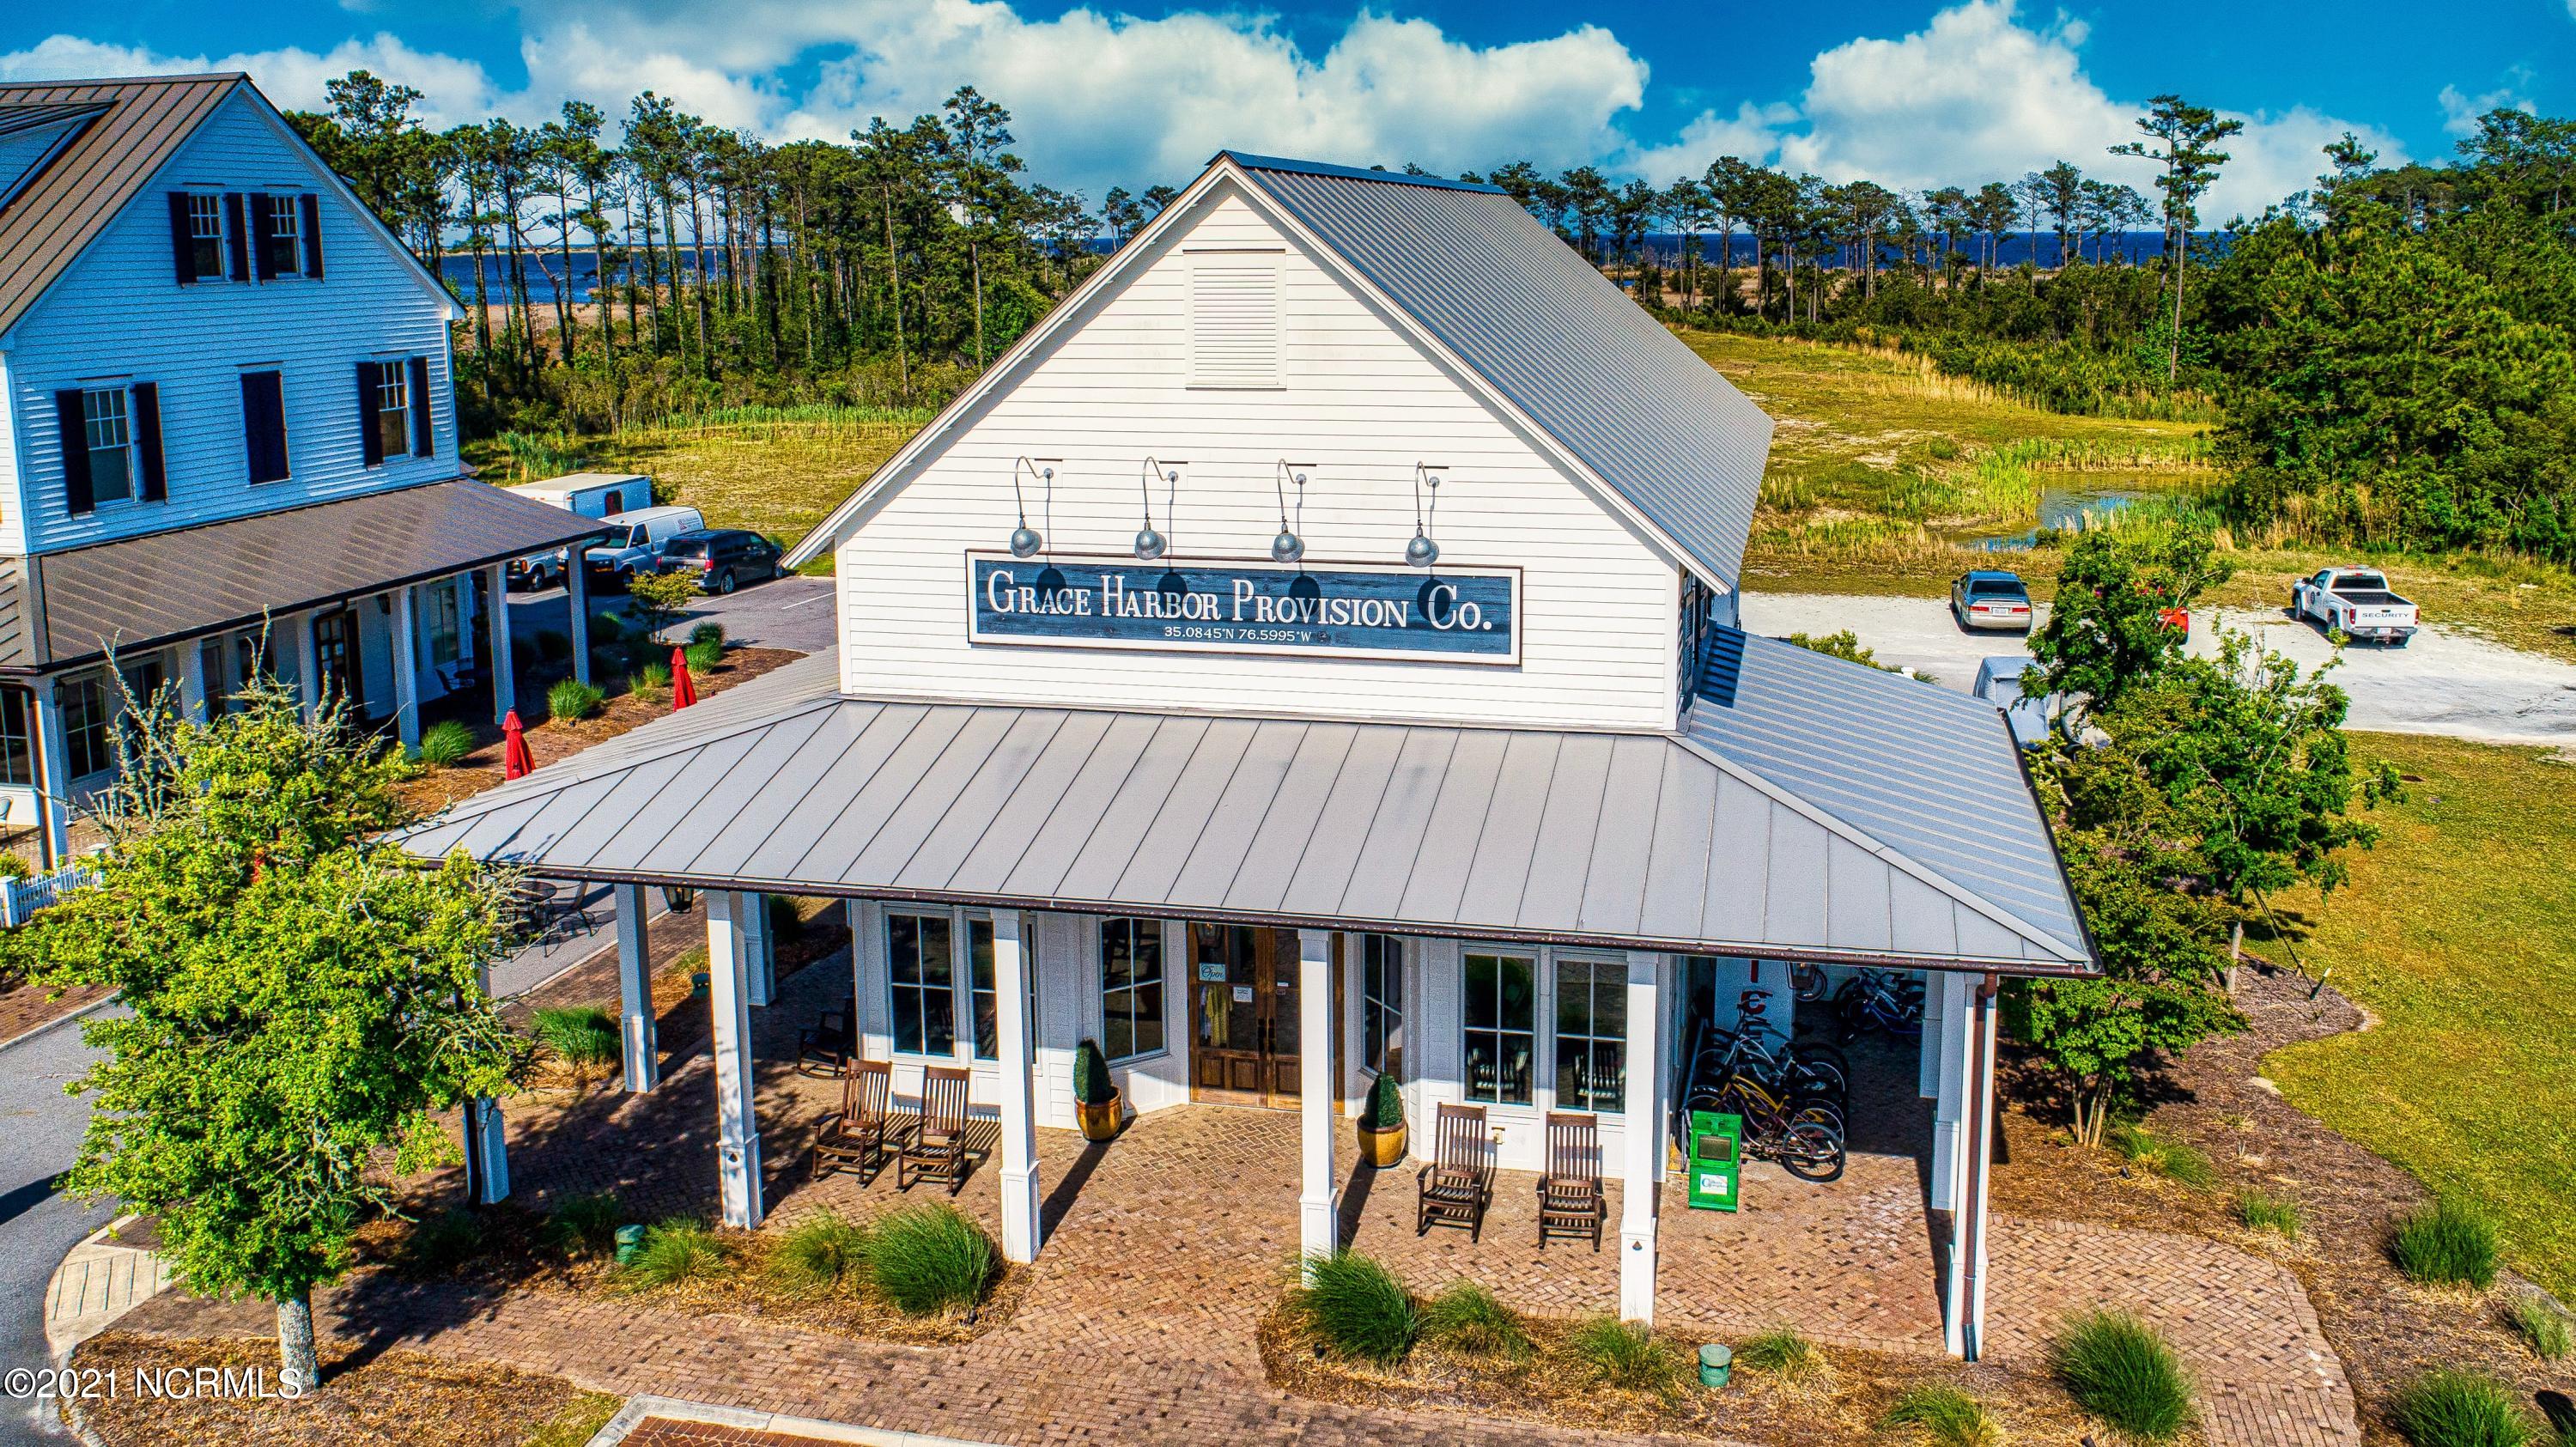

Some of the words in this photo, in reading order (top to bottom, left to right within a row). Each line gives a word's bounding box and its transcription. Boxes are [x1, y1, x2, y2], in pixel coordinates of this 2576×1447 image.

[988, 570, 1091, 616] GRACE
[1101, 575, 1221, 620] HARBOR
[1232, 579, 1409, 628] PROVISION
[1164, 626, 1234, 639] 35.0845°N
[1238, 629, 1312, 641] 76.5995°W
[1201, 965, 1224, 981] Open
